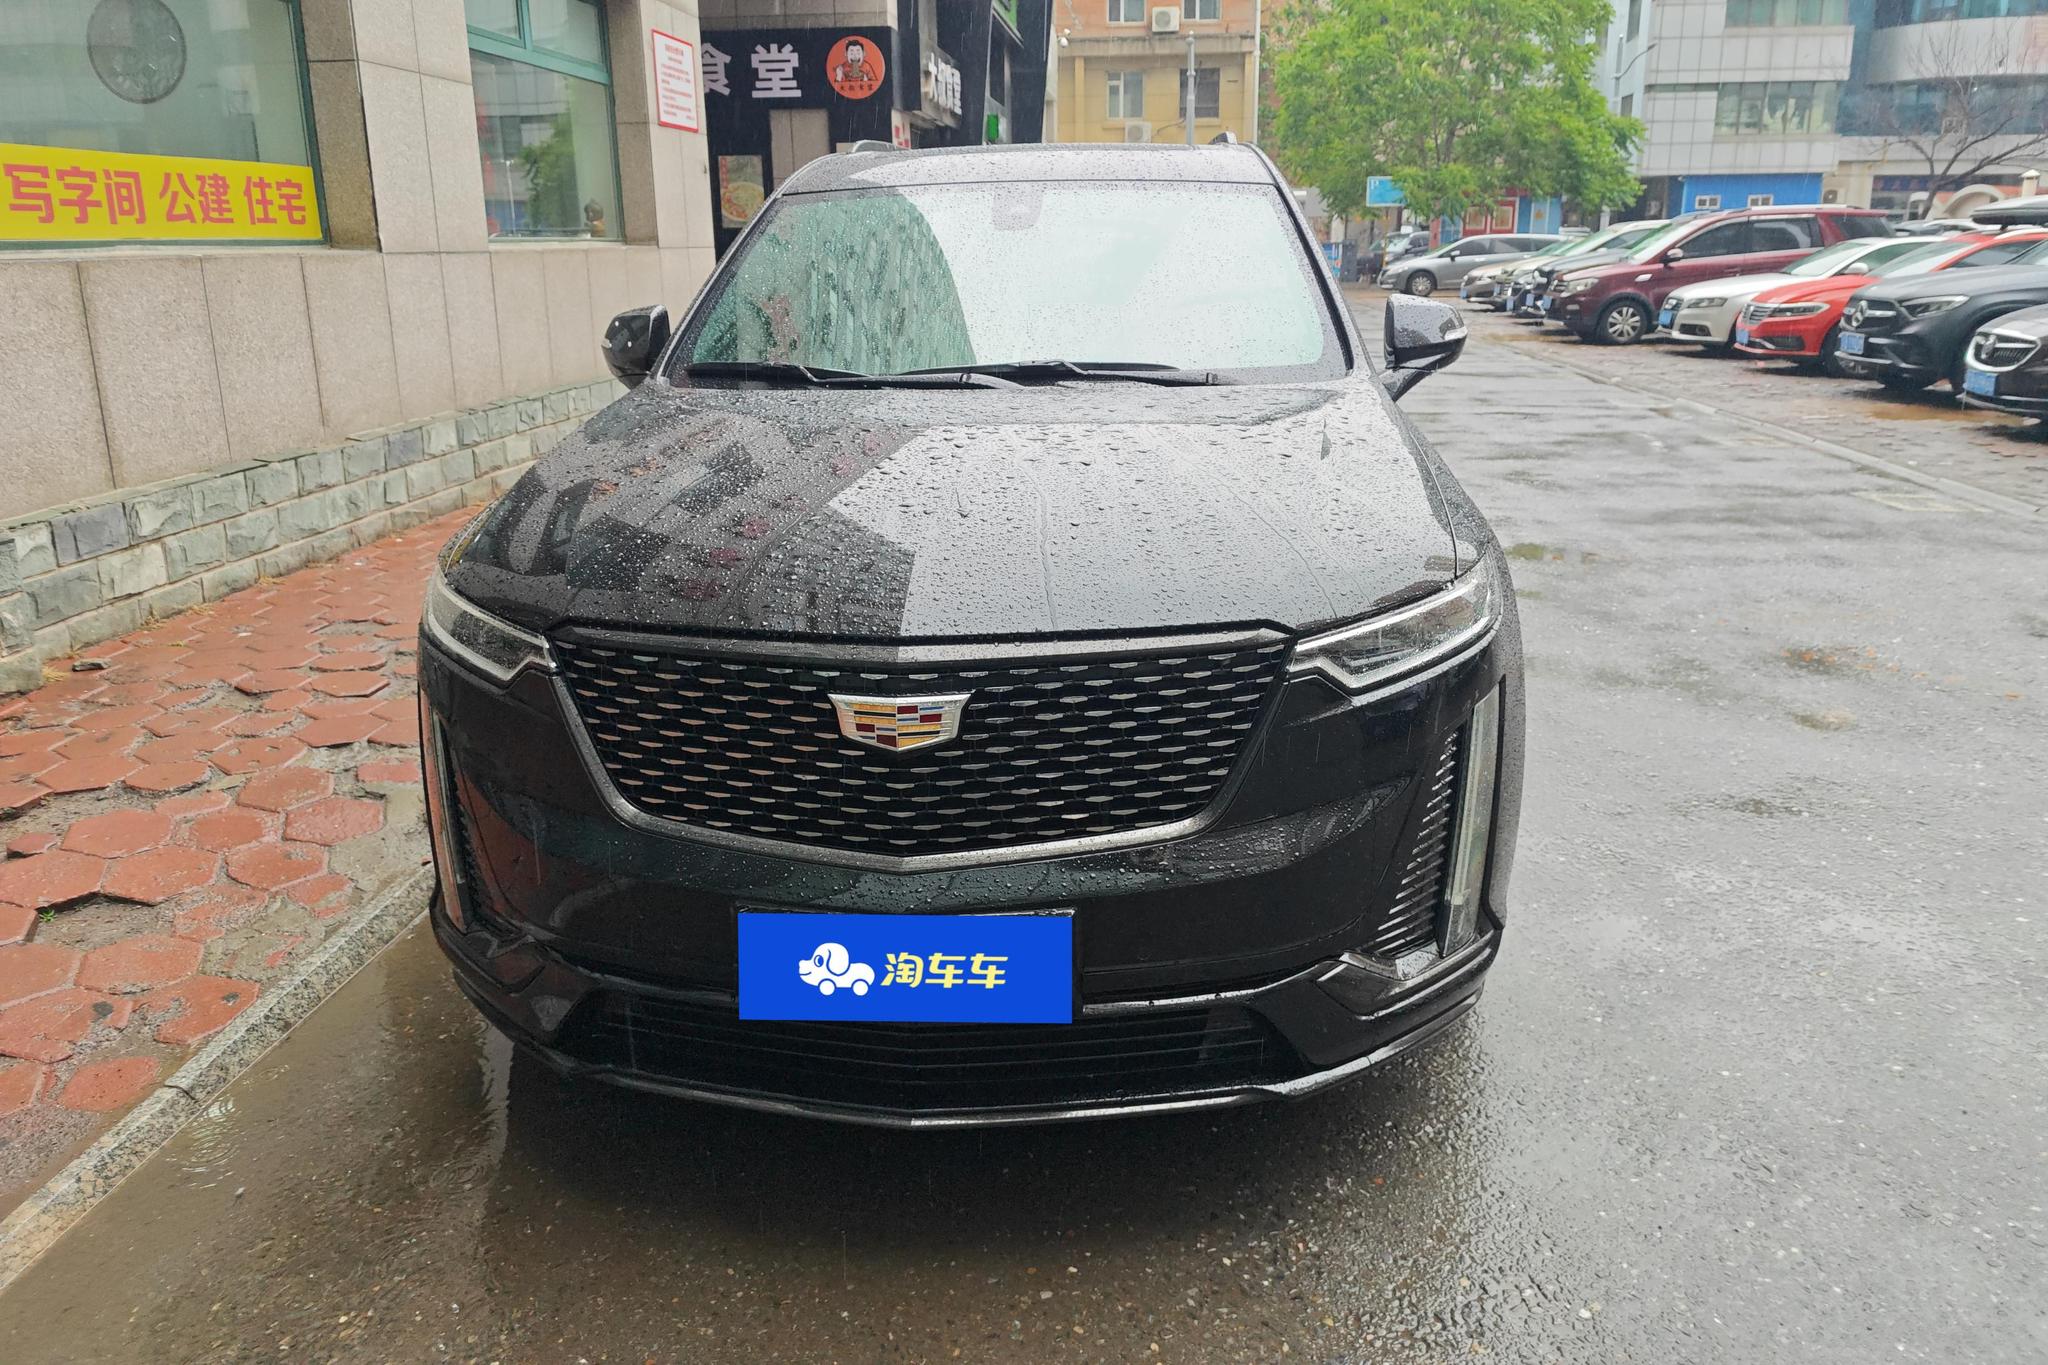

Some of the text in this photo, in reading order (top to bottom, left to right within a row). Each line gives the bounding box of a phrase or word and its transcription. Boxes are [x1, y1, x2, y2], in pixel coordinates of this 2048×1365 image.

[3, 163, 306, 225] 写字间 公建 住宅
